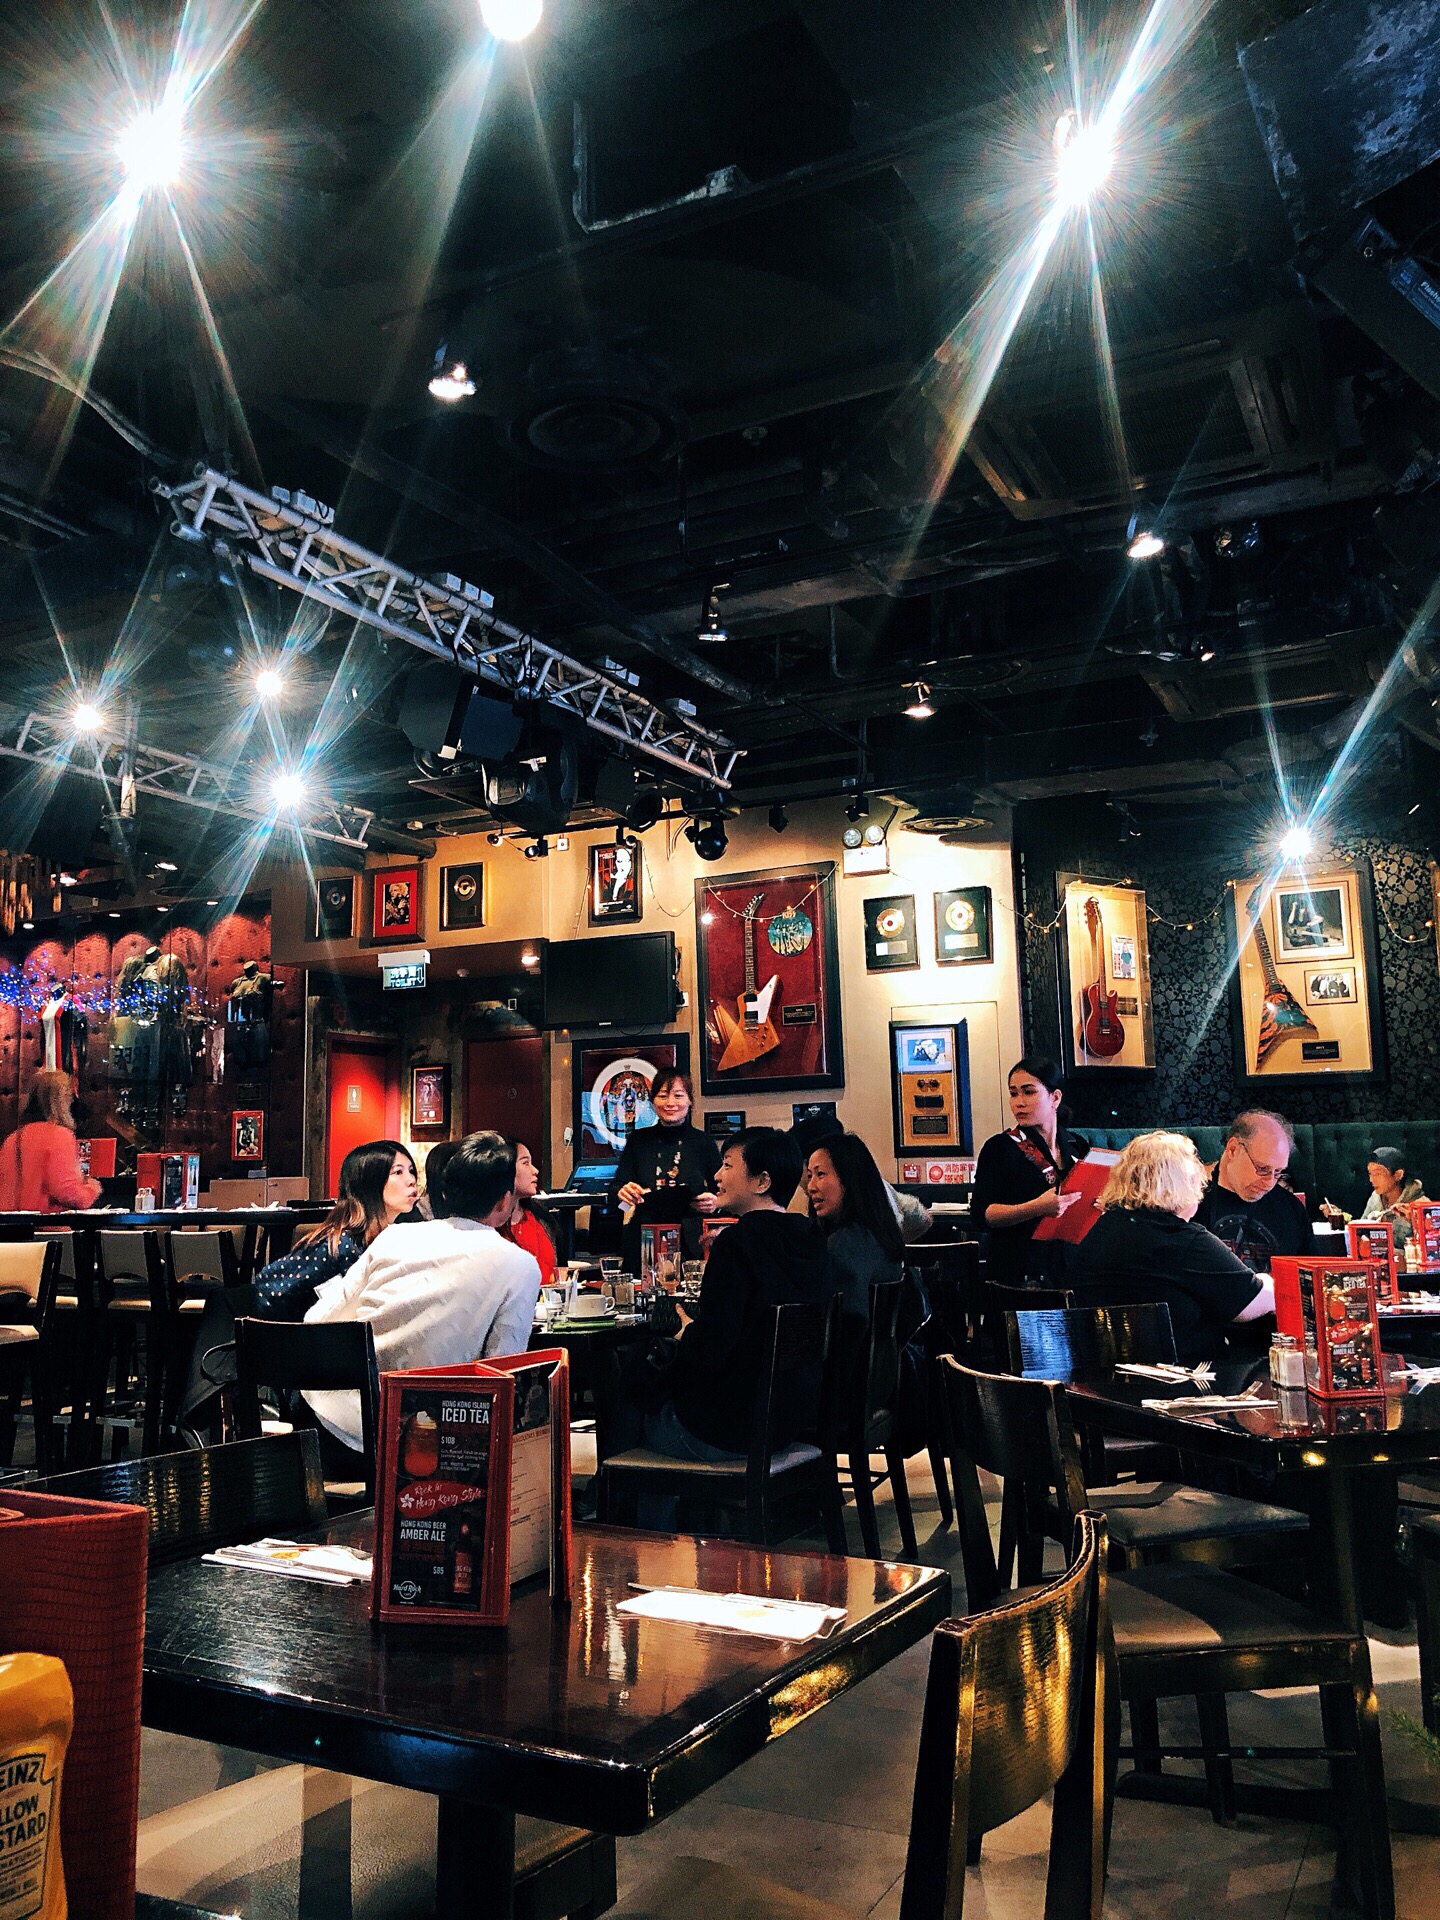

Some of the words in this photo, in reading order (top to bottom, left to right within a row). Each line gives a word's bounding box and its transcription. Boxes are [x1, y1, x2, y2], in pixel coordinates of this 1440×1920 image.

[442, 1400, 456, 1408] HONG
[457, 1401, 471, 1409] KONG
[472, 1402, 490, 1410] ISLAND
[442, 1408, 467, 1423] ICED
[470, 1409, 490, 1424] TEA
[416, 1497, 436, 1510] Hong
[438, 1494, 458, 1506] Kong
[461, 1488, 482, 1502] Style
[400, 1520, 416, 1528] HONG
[416, 1520, 432, 1529] KONG
[432, 1521, 447, 1530] BEER
[400, 1528, 429, 1541] AMBER
[430, 1530, 446, 1542] ALE
[433, 1566, 445, 1575] $85
[393, 1583, 408, 1591] Hard
[408, 1584, 422, 1594] Rock
